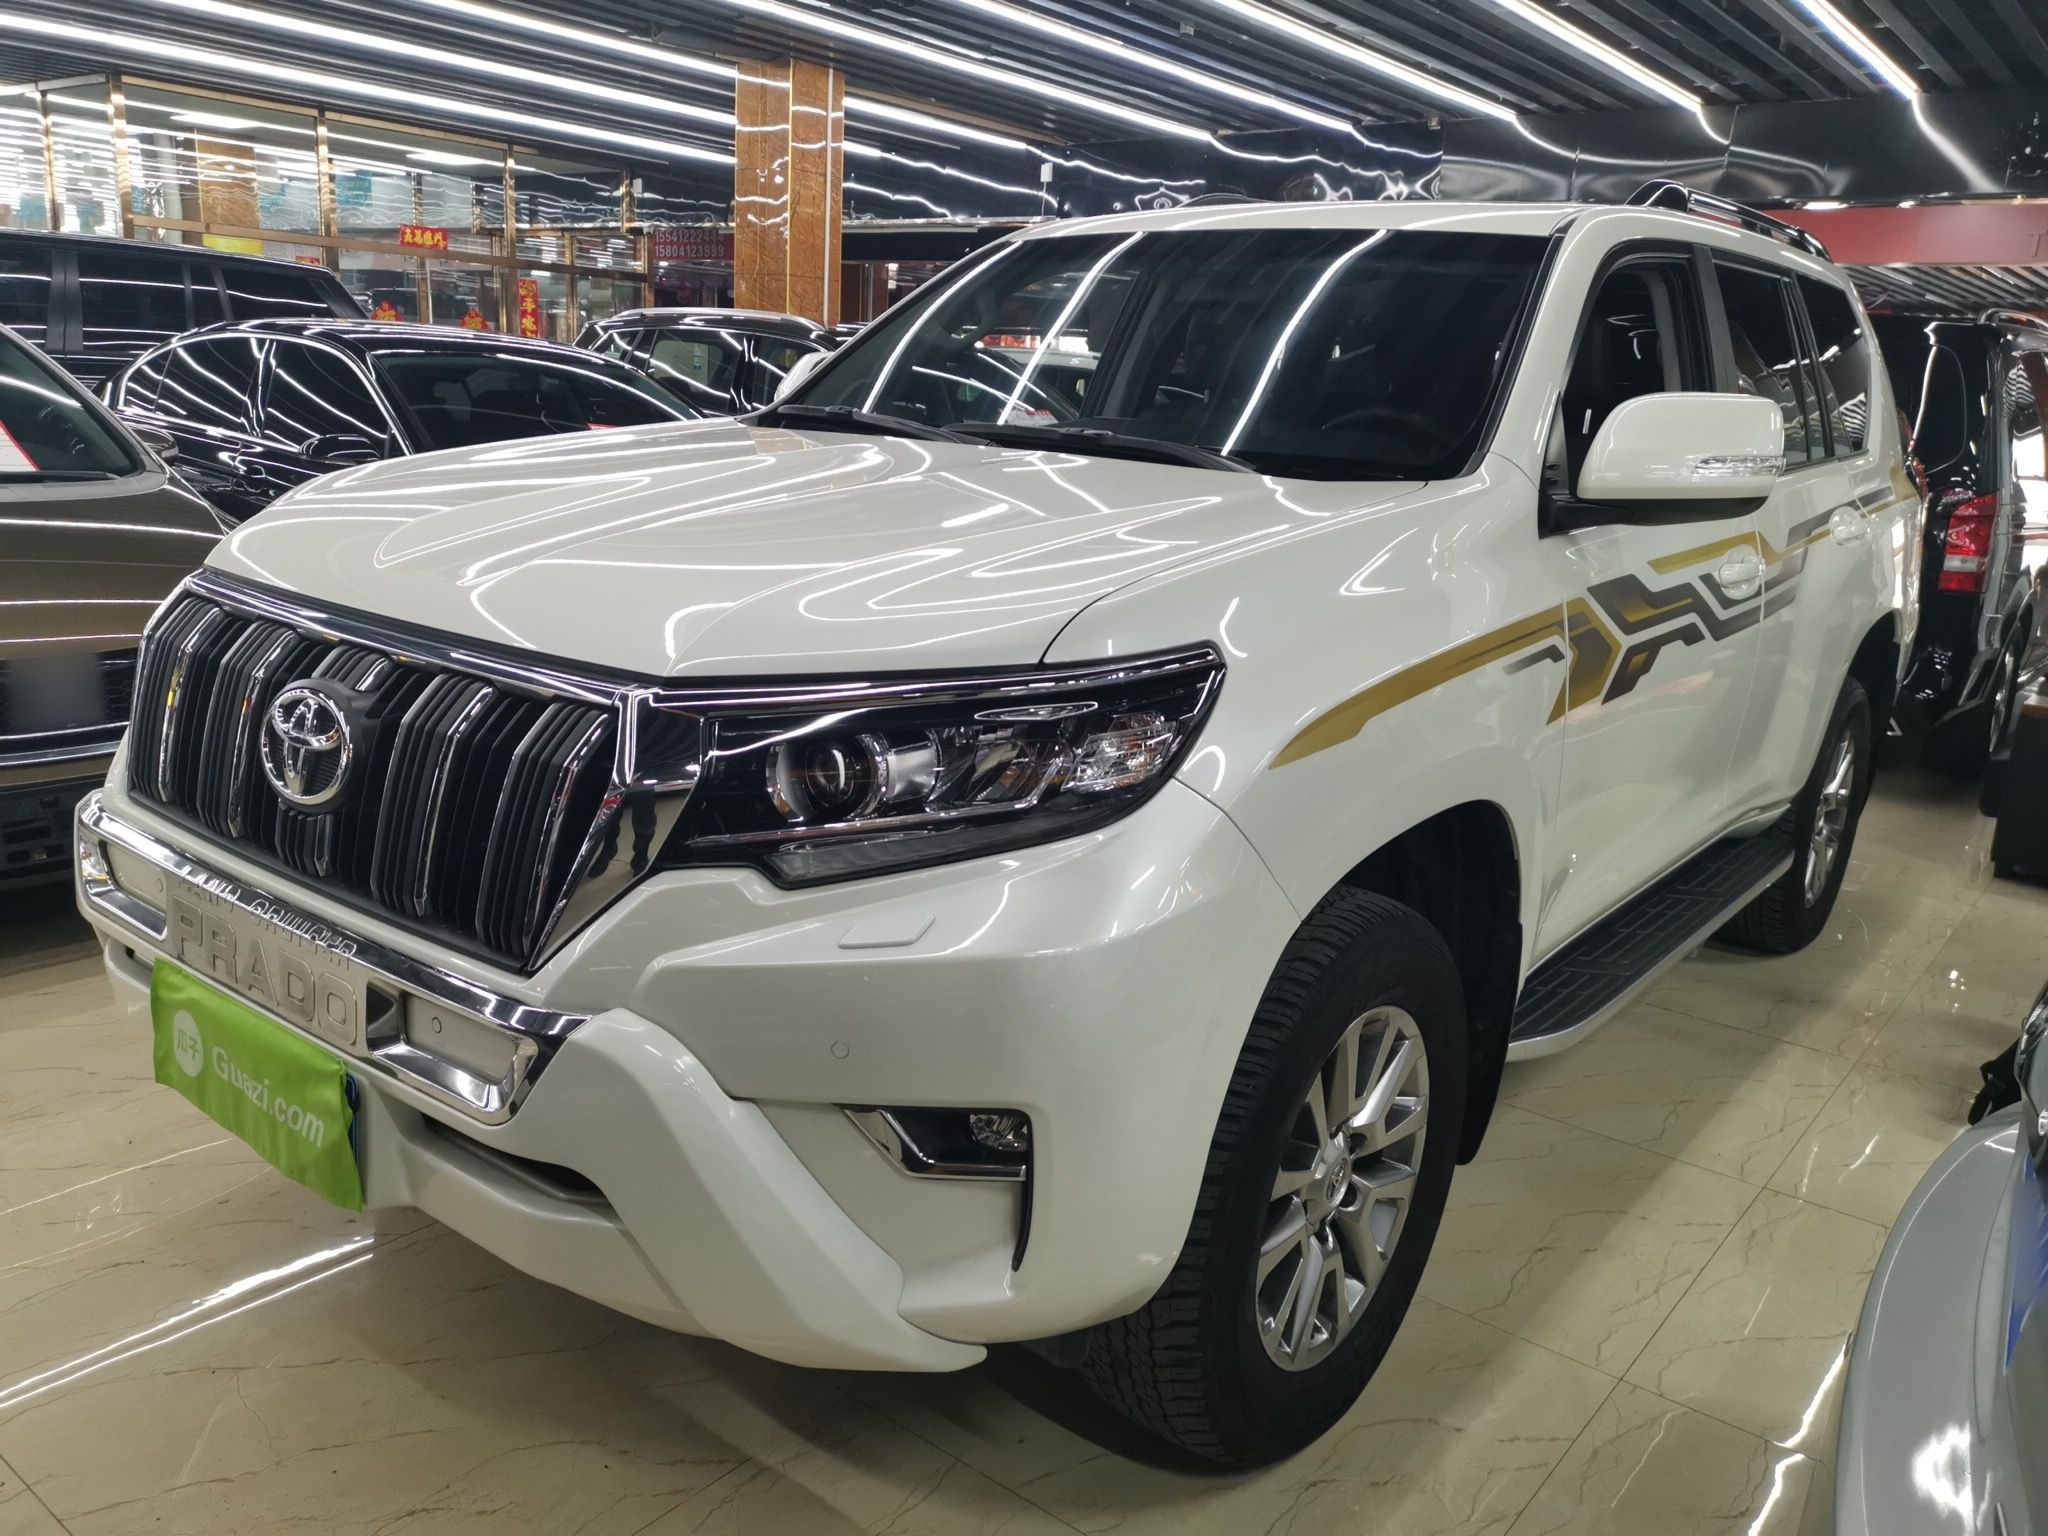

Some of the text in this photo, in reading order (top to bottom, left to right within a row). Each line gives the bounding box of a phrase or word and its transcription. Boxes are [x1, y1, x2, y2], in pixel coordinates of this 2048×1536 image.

[655, 245, 724, 257] 15804123999
[171, 895, 358, 1046] PRADO
[176, 1028, 200, 1061] 瓜子
[212, 1046, 325, 1148] Guazi.com
